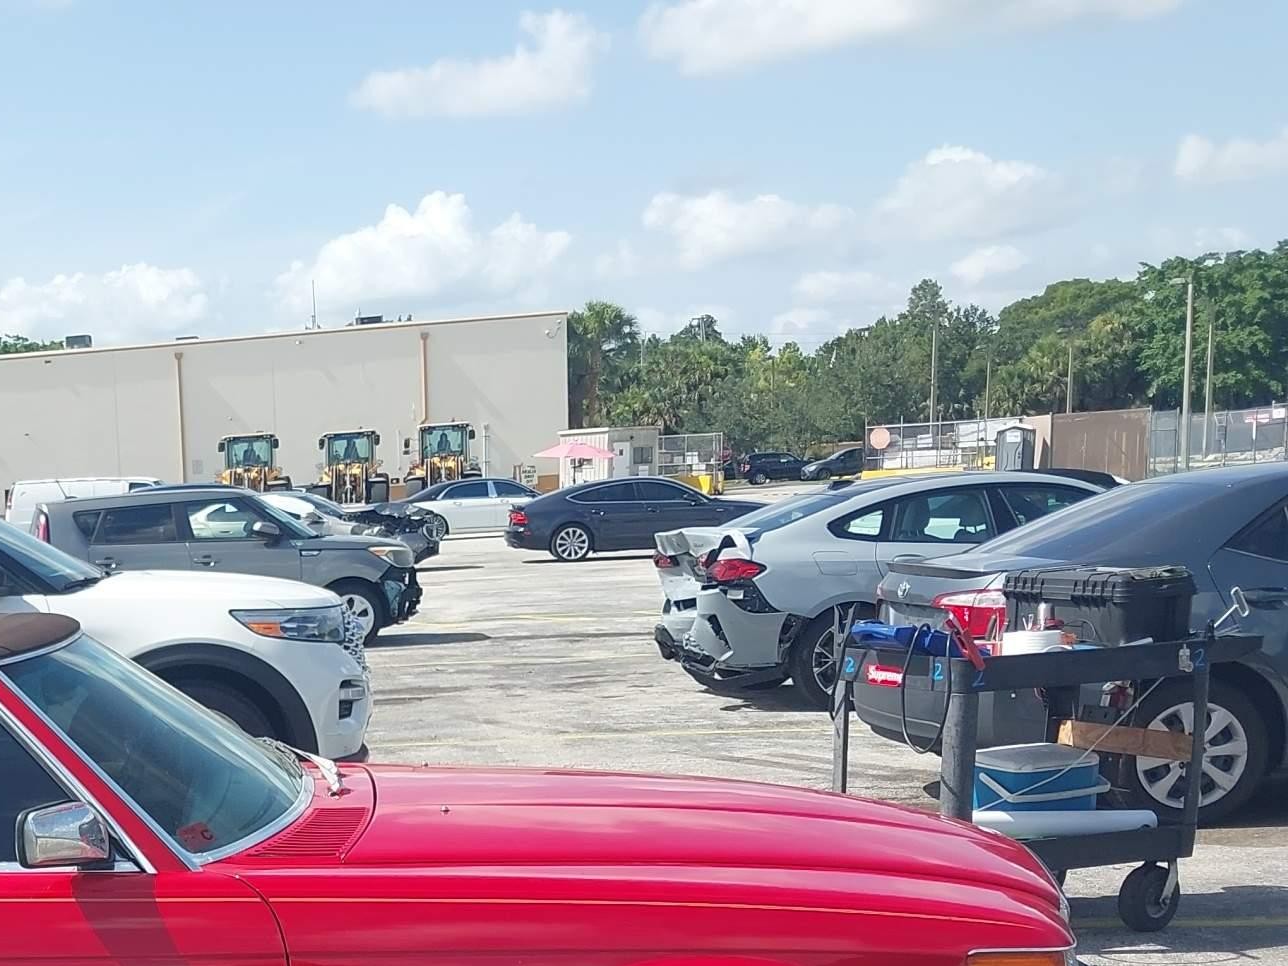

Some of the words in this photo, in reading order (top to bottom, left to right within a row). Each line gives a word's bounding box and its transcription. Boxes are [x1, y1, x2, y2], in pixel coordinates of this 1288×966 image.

[845, 656, 855, 673] 2
[1192, 648, 1205, 667] 2
[867, 664, 904, 684] Suprem
[933, 663, 944, 681] 2
